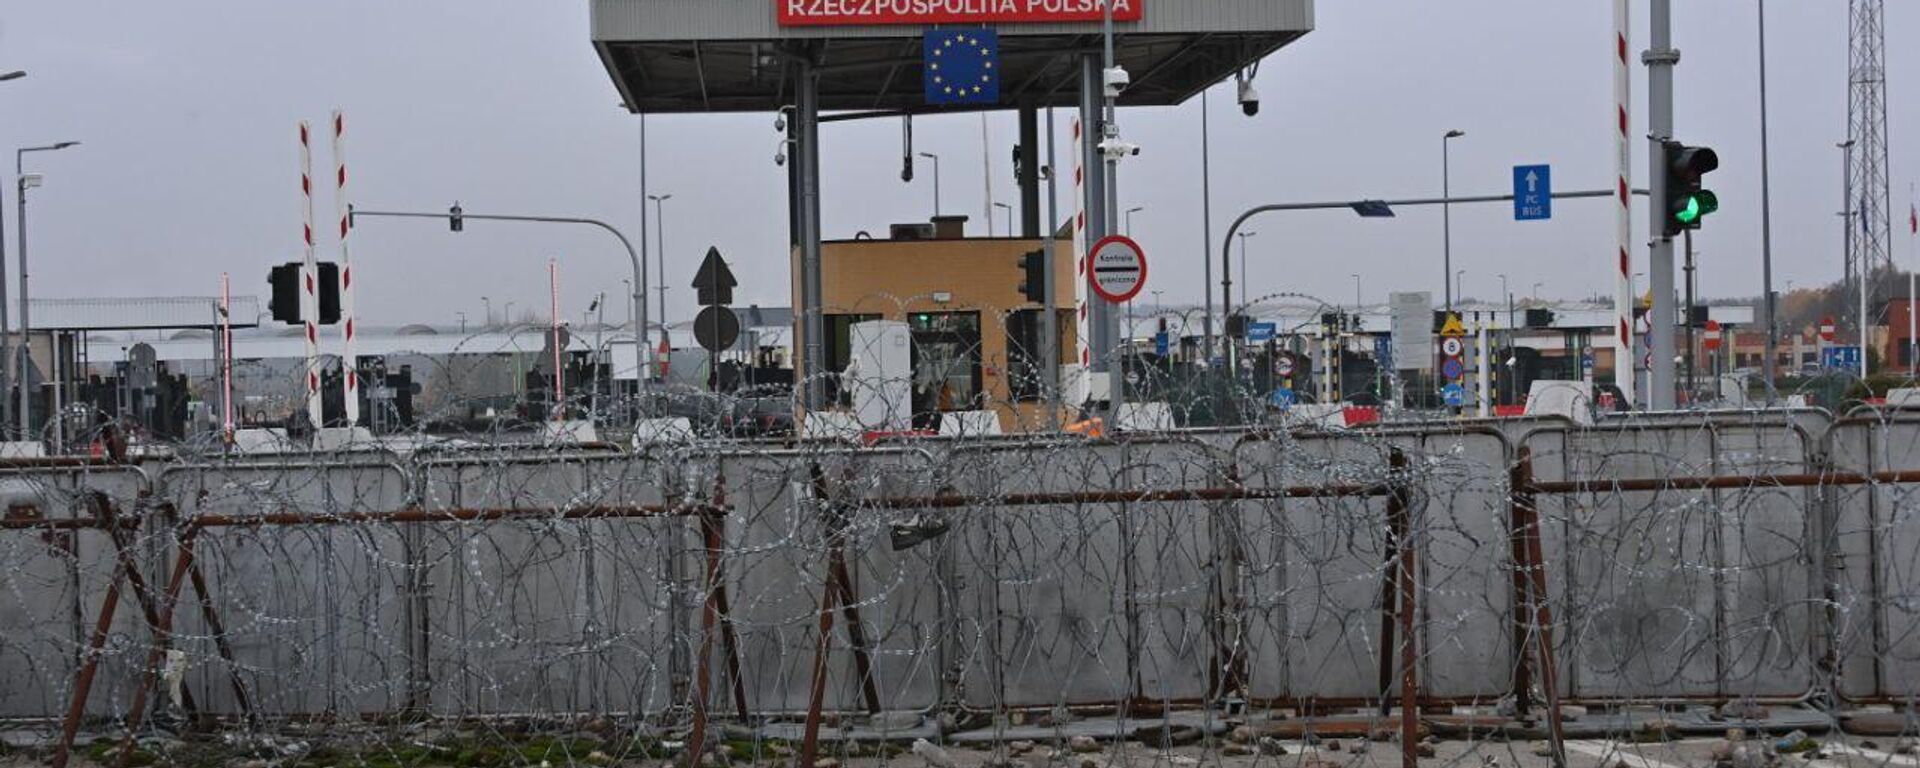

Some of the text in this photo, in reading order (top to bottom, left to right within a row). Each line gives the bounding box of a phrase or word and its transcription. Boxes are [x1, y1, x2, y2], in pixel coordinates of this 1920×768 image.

[788, 0, 1017, 16] RZECZPOSPOLITA
[1525, 195, 1538, 204] PC
[1522, 206, 1542, 216] BUS
[1100, 253, 1133, 262] Kontrola
[1099, 274, 1136, 285] graniczna
